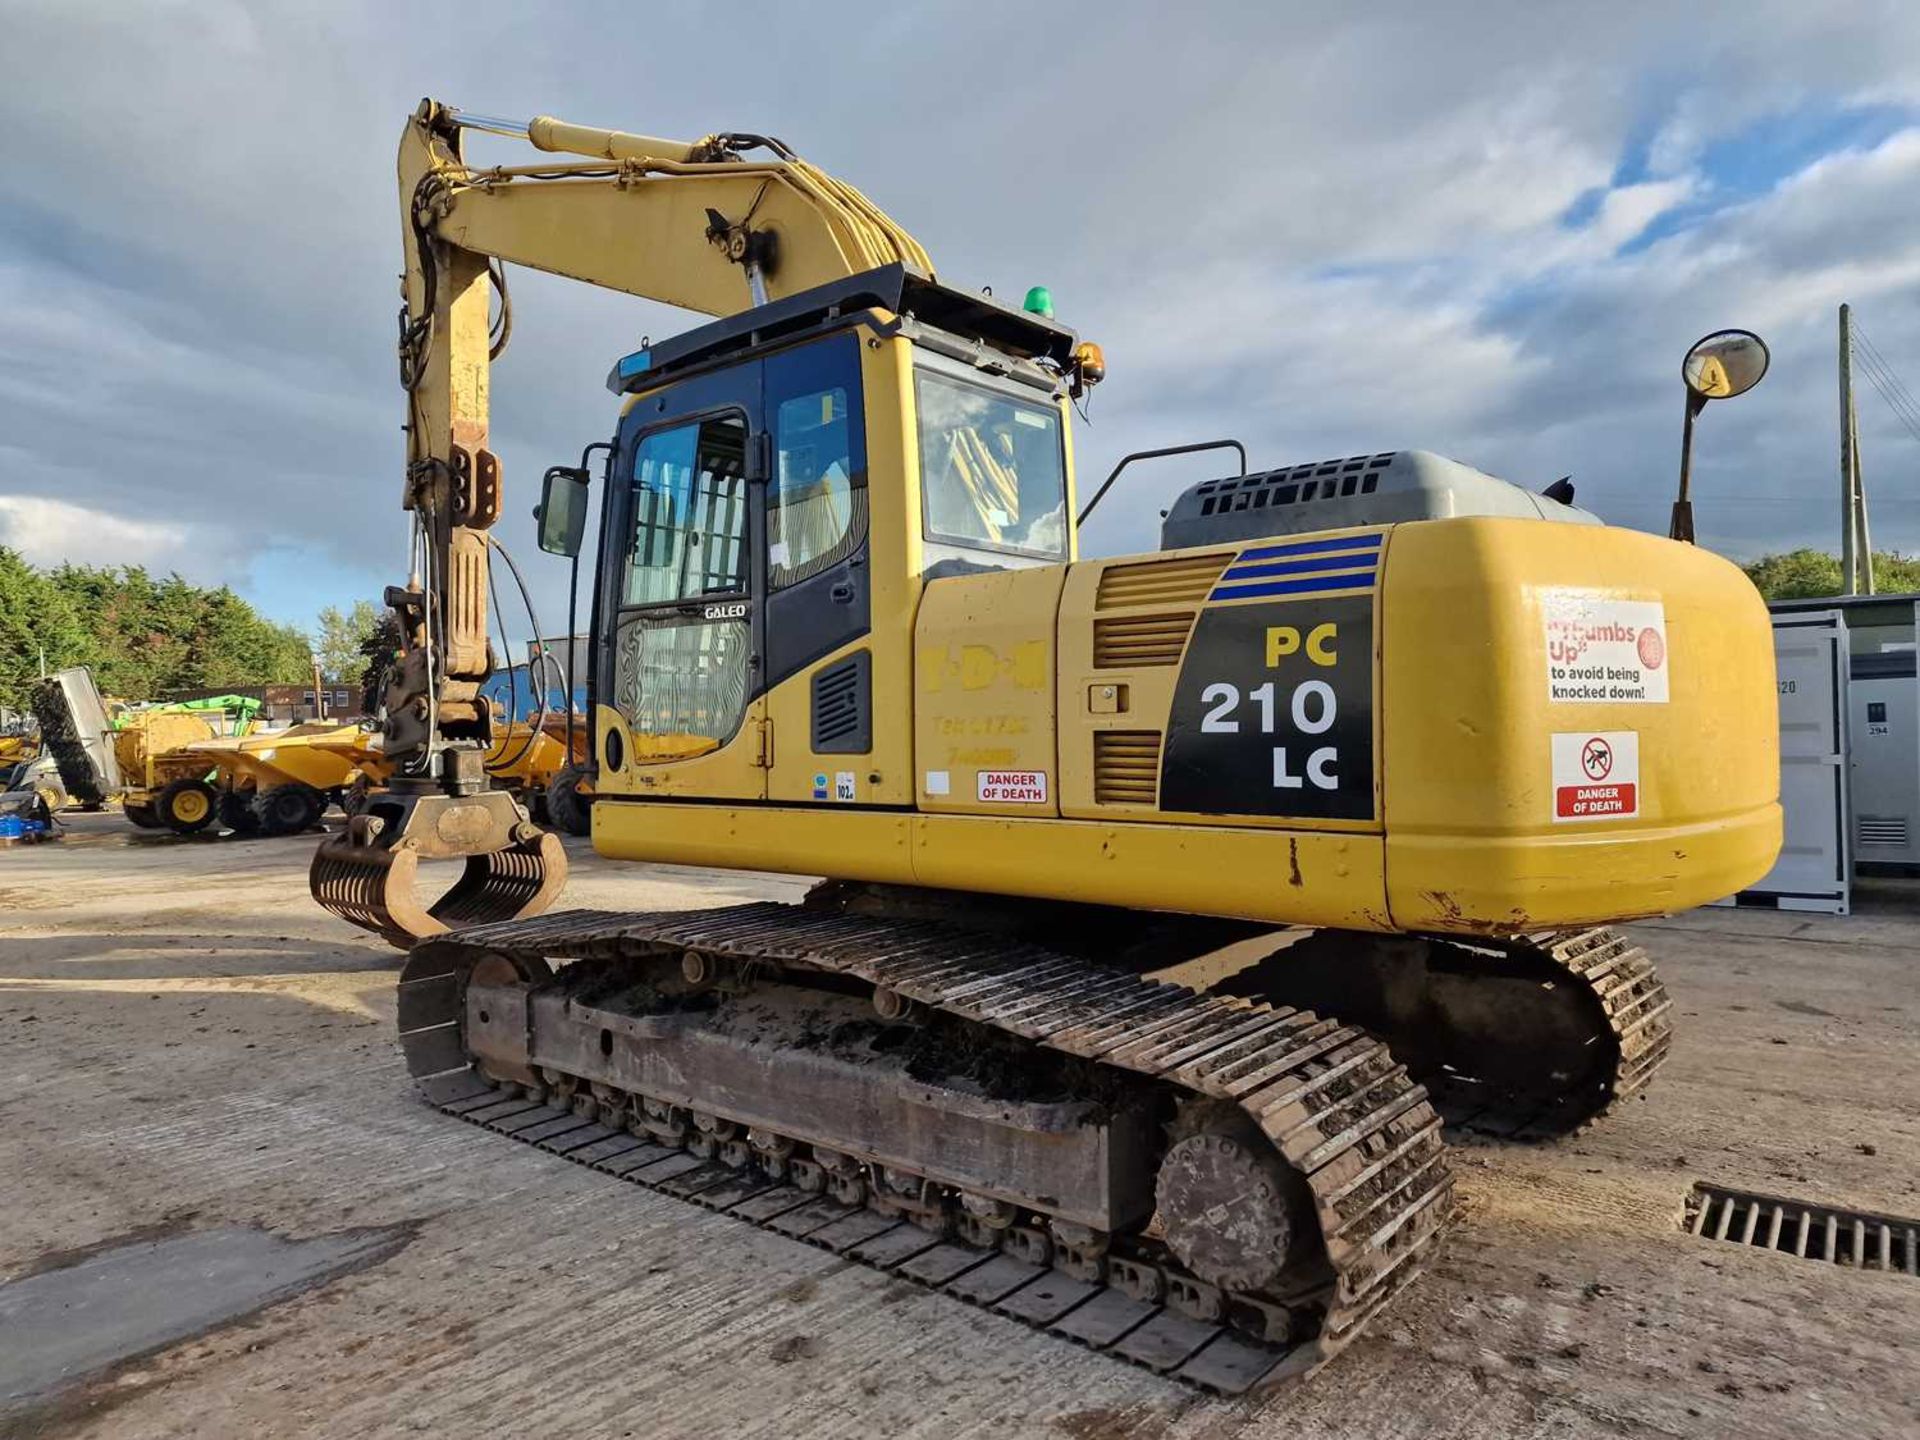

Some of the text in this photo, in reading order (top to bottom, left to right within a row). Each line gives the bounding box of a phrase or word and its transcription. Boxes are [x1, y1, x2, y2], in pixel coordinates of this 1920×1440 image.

[705, 605, 746, 619] GALEO
[1265, 623, 1338, 668] PC
[1551, 666, 1640, 683] to avoid being
[1552, 685, 1645, 699] knocked down!
[1200, 680, 1338, 735] 210
[1272, 747, 1339, 790] LC
[987, 774, 1037, 786] DANGER
[983, 788, 1042, 800] OF DEATH
[1577, 788, 1619, 800] DANGER
[1573, 801, 1623, 813] OF DEATH
